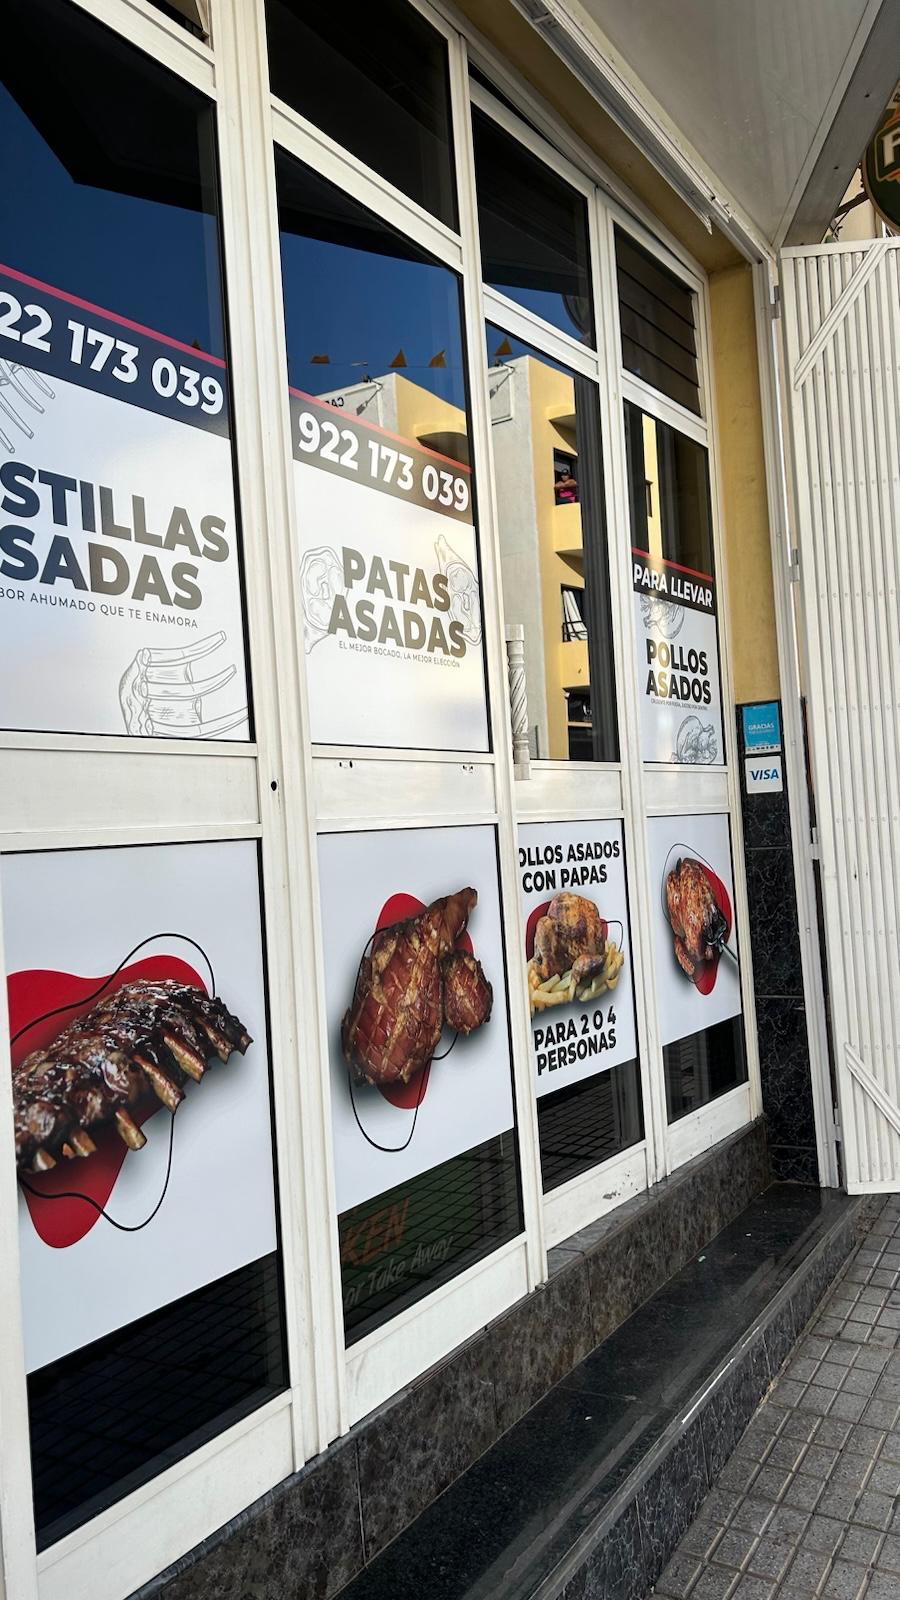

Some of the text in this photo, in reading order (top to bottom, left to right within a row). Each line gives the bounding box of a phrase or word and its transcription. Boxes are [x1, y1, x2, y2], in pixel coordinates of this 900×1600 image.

[0, 291, 224, 415] 22 173 039
[298, 412, 469, 512] 922 173 039
[0, 461, 230, 563] STILLAS
[0, 524, 203, 610] SADAS
[342, 546, 451, 612] PATAS
[633, 563, 713, 608] PARA LLEVAR
[30, 592, 96, 612] AHUMADO
[100, 604, 125, 617] QUE
[128, 608, 142, 620] TE
[146, 611, 198, 629] ENAMORA
[327, 594, 467, 659] ASADAS
[339, 640, 461, 669] EL MEJOR BOCADO, LA MEJOR ELECCIÓN
[646, 638, 709, 676] POLLOS
[646, 669, 711, 705] ASADOS
[748, 768, 779, 781] VISA
[567, 840, 620, 862] ASADOS
[522, 864, 607, 893] CON PAPAS
[534, 1018, 577, 1051] PARA
[580, 1014, 590, 1035] 2
[607, 1005, 617, 1025] 4
[537, 1028, 617, 1076] PERSONAS
[367, 1258, 406, 1294] Take
[410, 1236, 454, 1272] Away
